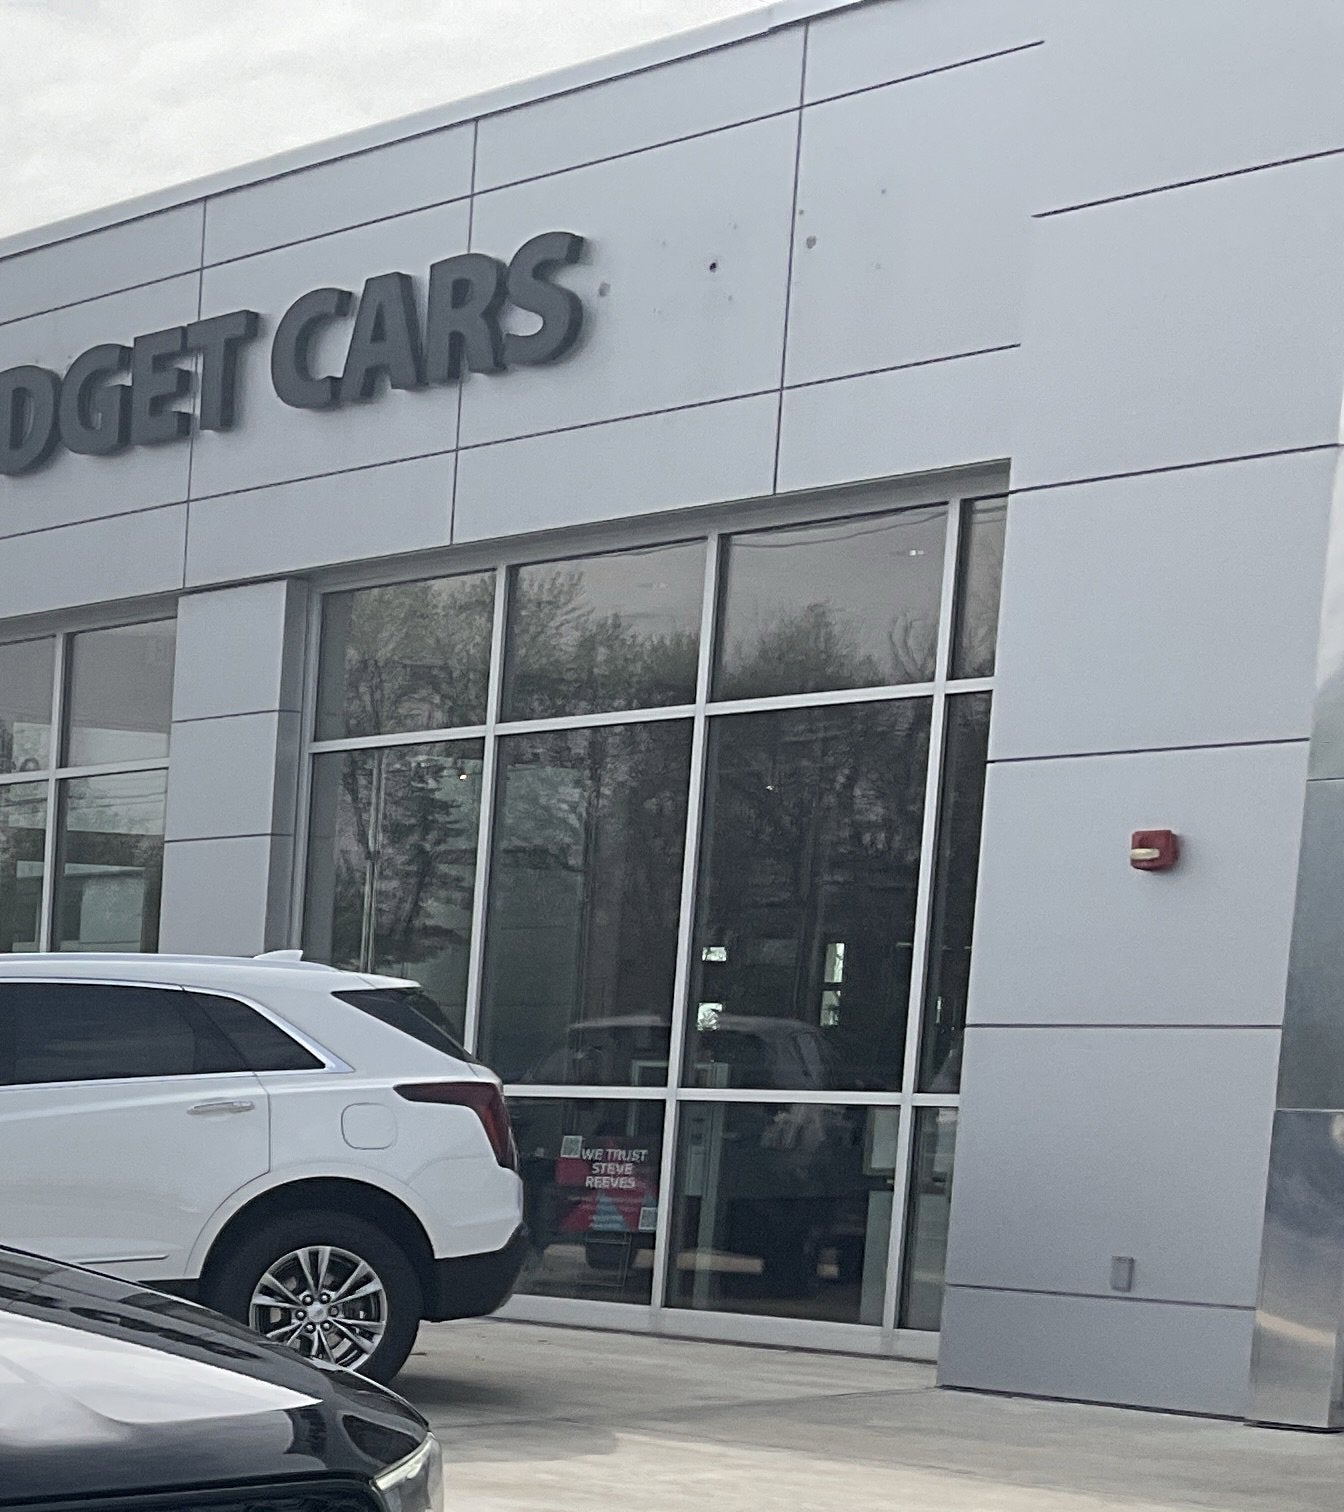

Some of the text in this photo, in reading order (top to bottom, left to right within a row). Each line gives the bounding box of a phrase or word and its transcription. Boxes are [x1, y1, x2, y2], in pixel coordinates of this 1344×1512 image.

[270, 230, 585, 409] CARS
[581, 1148, 648, 1162] WE TRUST
[591, 1162, 633, 1175] STEVE
[585, 1175, 636, 1189] REEVES
